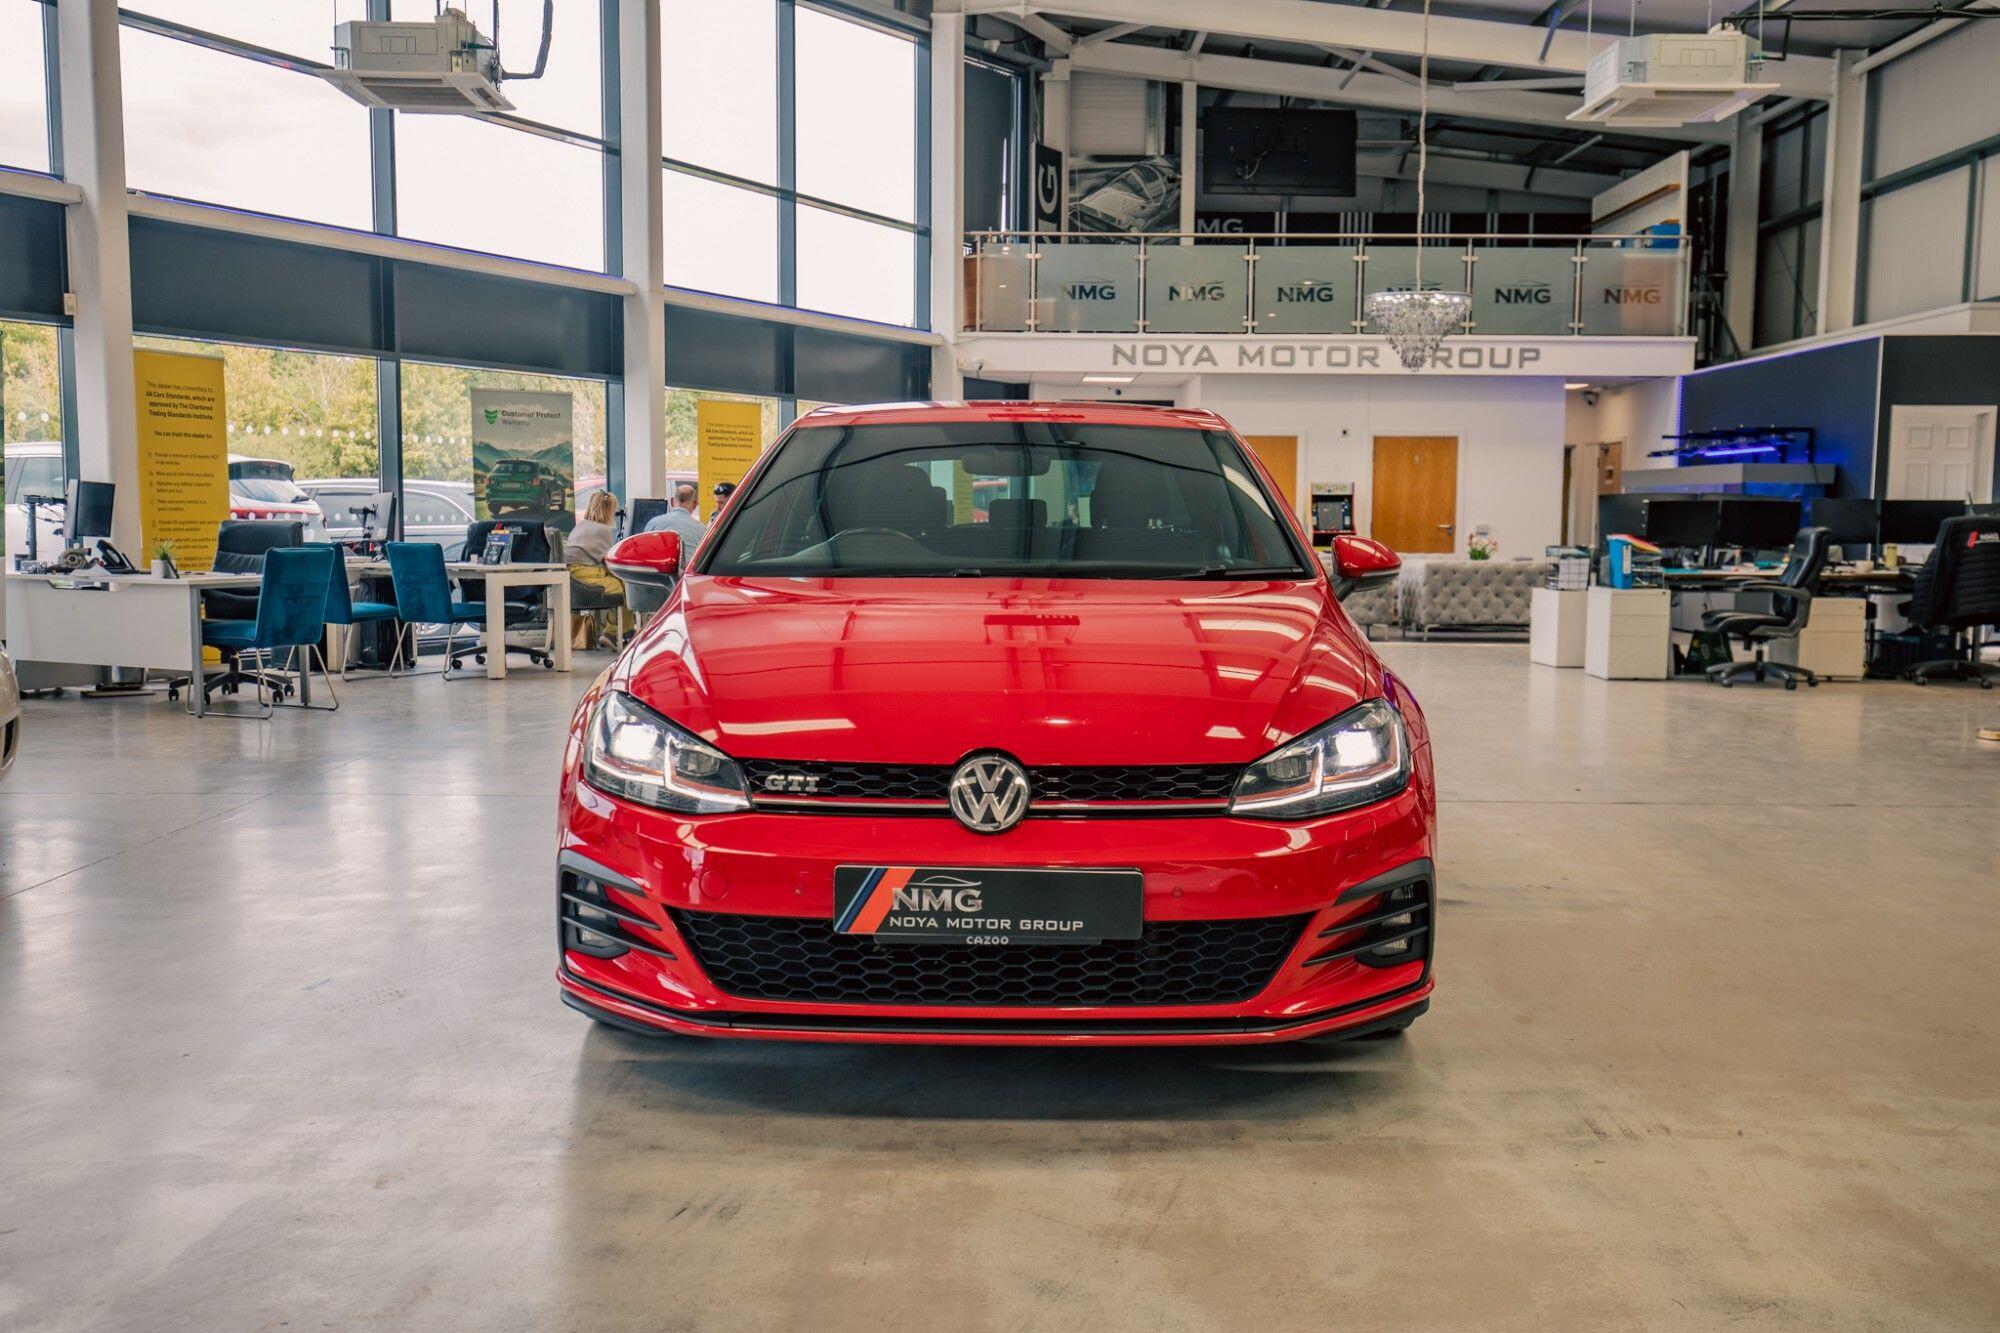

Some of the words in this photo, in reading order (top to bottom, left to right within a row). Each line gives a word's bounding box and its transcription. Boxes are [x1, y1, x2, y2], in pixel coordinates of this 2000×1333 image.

[1197, 218, 1243, 234] MG
[1060, 284, 1116, 300] NMG
[1277, 286, 1334, 302] NMG
[1494, 287, 1551, 304] NMG
[1603, 287, 1662, 304] NMG
[1112, 344, 1218, 366] NOYA
[1238, 345, 1380, 368] MOTOR
[501, 410, 534, 418] Customer
[536, 411, 562, 419] Protect
[765, 774, 820, 792] GTI
[951, 757, 1029, 832] VW
[892, 887, 983, 912] NMG
[889, 916, 939, 928] NOYA
[946, 917, 1011, 930] MOTOR
[1019, 919, 1083, 932] GROUP
[966, 936, 1009, 945] CAZOO
